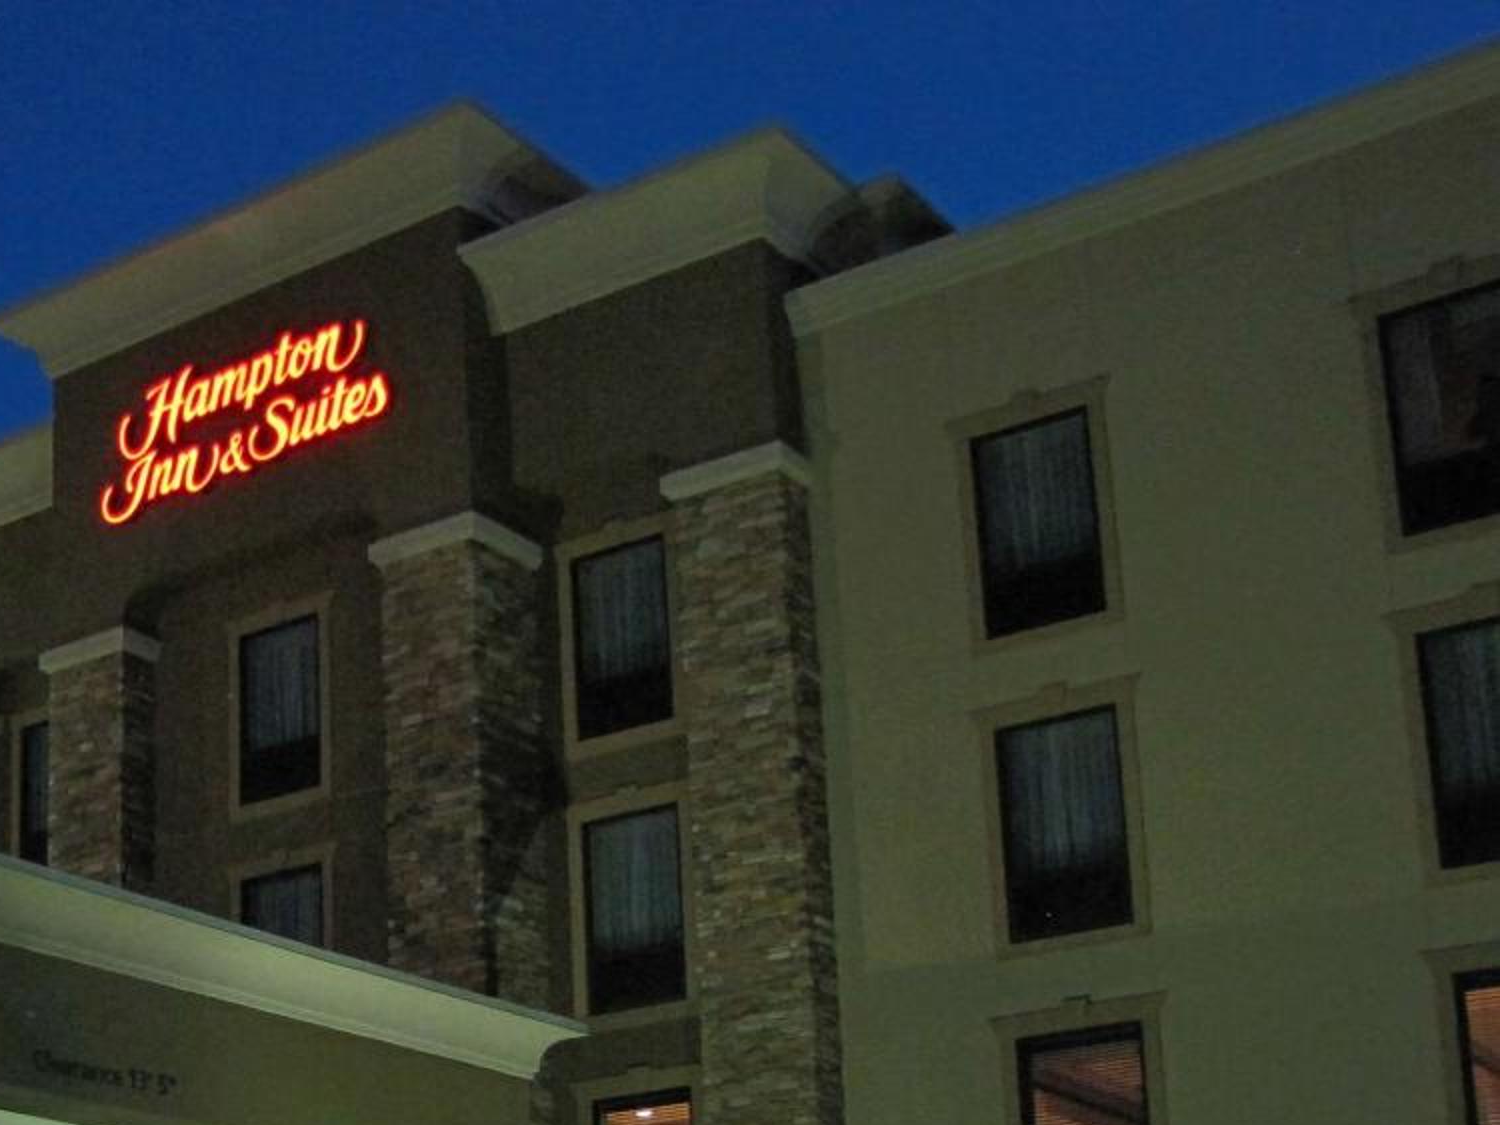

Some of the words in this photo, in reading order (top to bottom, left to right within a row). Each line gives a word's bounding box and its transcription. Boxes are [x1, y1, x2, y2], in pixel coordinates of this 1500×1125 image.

[100, 443, 219, 525] Inn
[219, 431, 252, 475] &
[246, 373, 389, 462] Suites
[117, 320, 366, 461] Hampton
